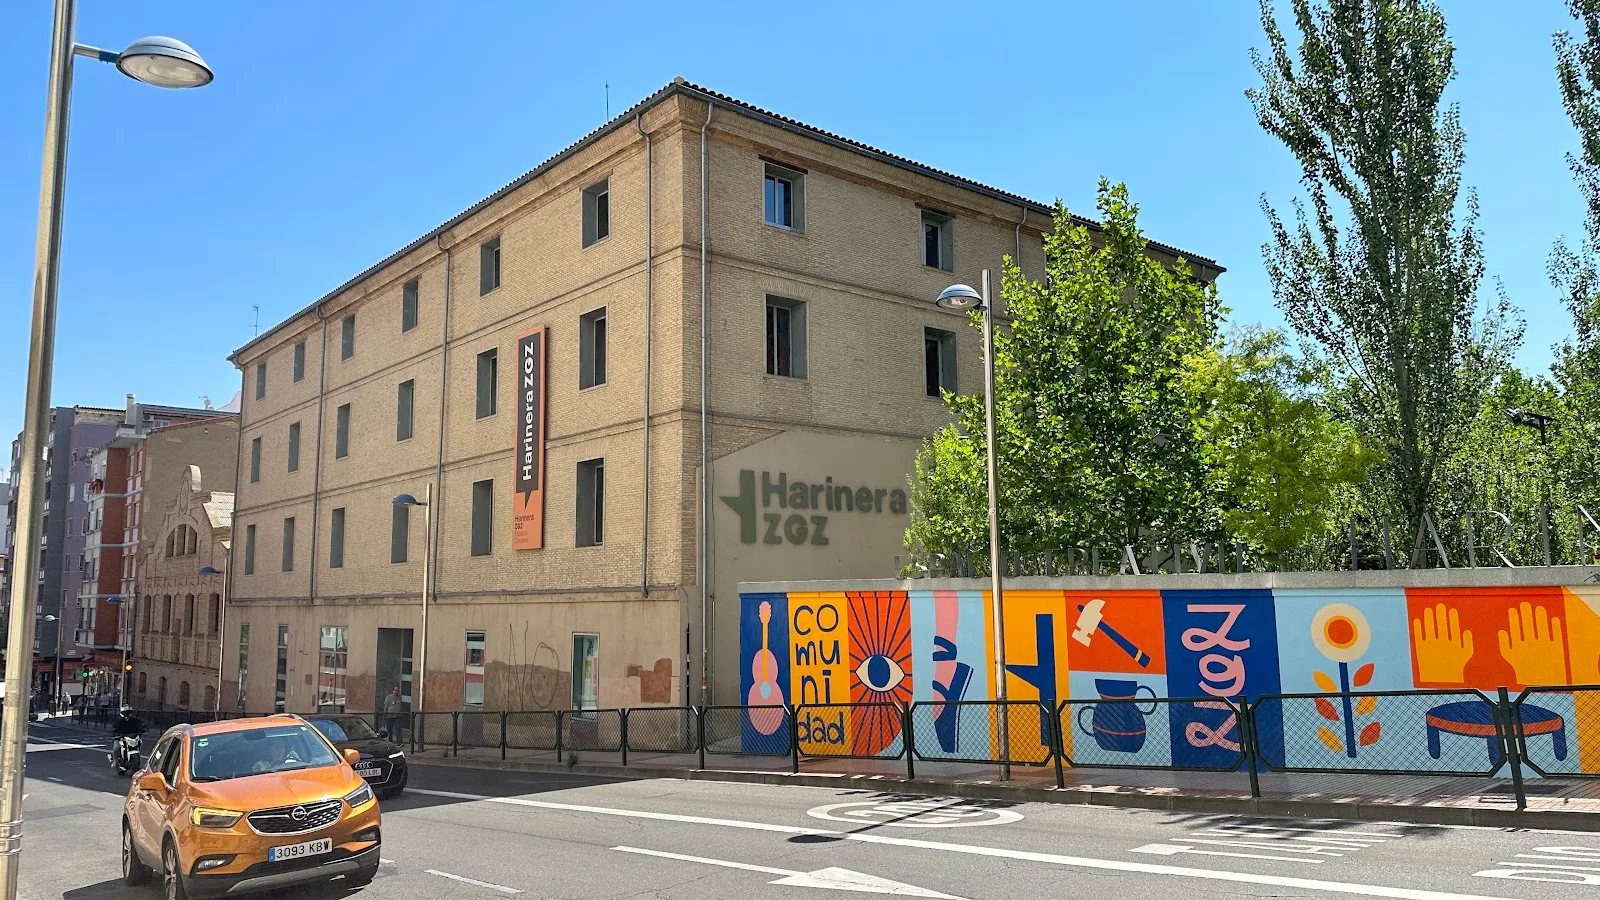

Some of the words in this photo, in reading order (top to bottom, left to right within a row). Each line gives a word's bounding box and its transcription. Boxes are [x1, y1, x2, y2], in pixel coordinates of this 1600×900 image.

[524, 342, 534, 388] ZGZ
[523, 391, 534, 480] Harinera
[762, 471, 907, 514] Harinera
[763, 513, 829, 545] ZGZ
[801, 669, 831, 704] ni
[797, 711, 845, 745] dad
[276, 845, 305, 858] 3093
[309, 841, 330, 853] KBW
